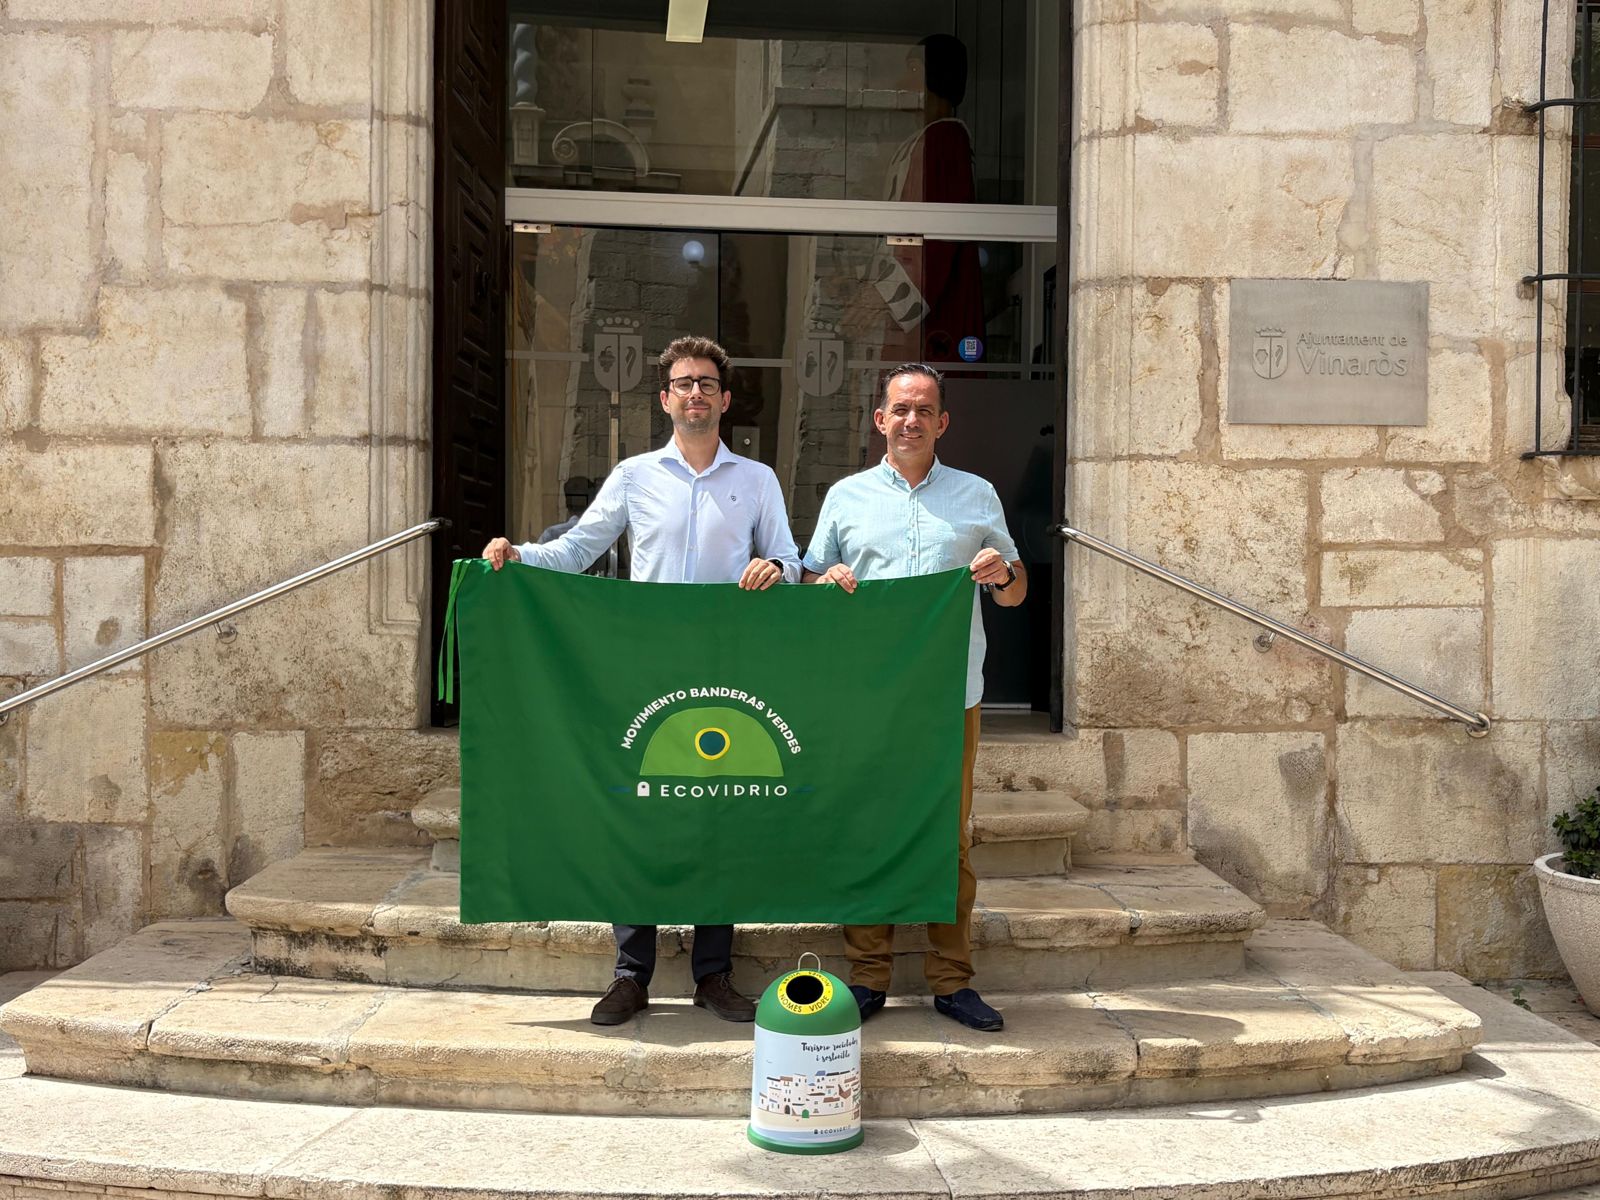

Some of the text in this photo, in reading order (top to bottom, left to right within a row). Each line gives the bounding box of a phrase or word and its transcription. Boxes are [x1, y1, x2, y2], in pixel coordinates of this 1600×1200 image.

[1297, 332, 1408, 349] Ajuntament de
[1296, 346, 1409, 377] Vinaròs
[620, 686, 802, 755] MOVIMIENTO BANDERAS VERDES
[660, 784, 788, 798] ECOVIDRIO
[779, 993, 830, 1013] NOMES VIDRE
